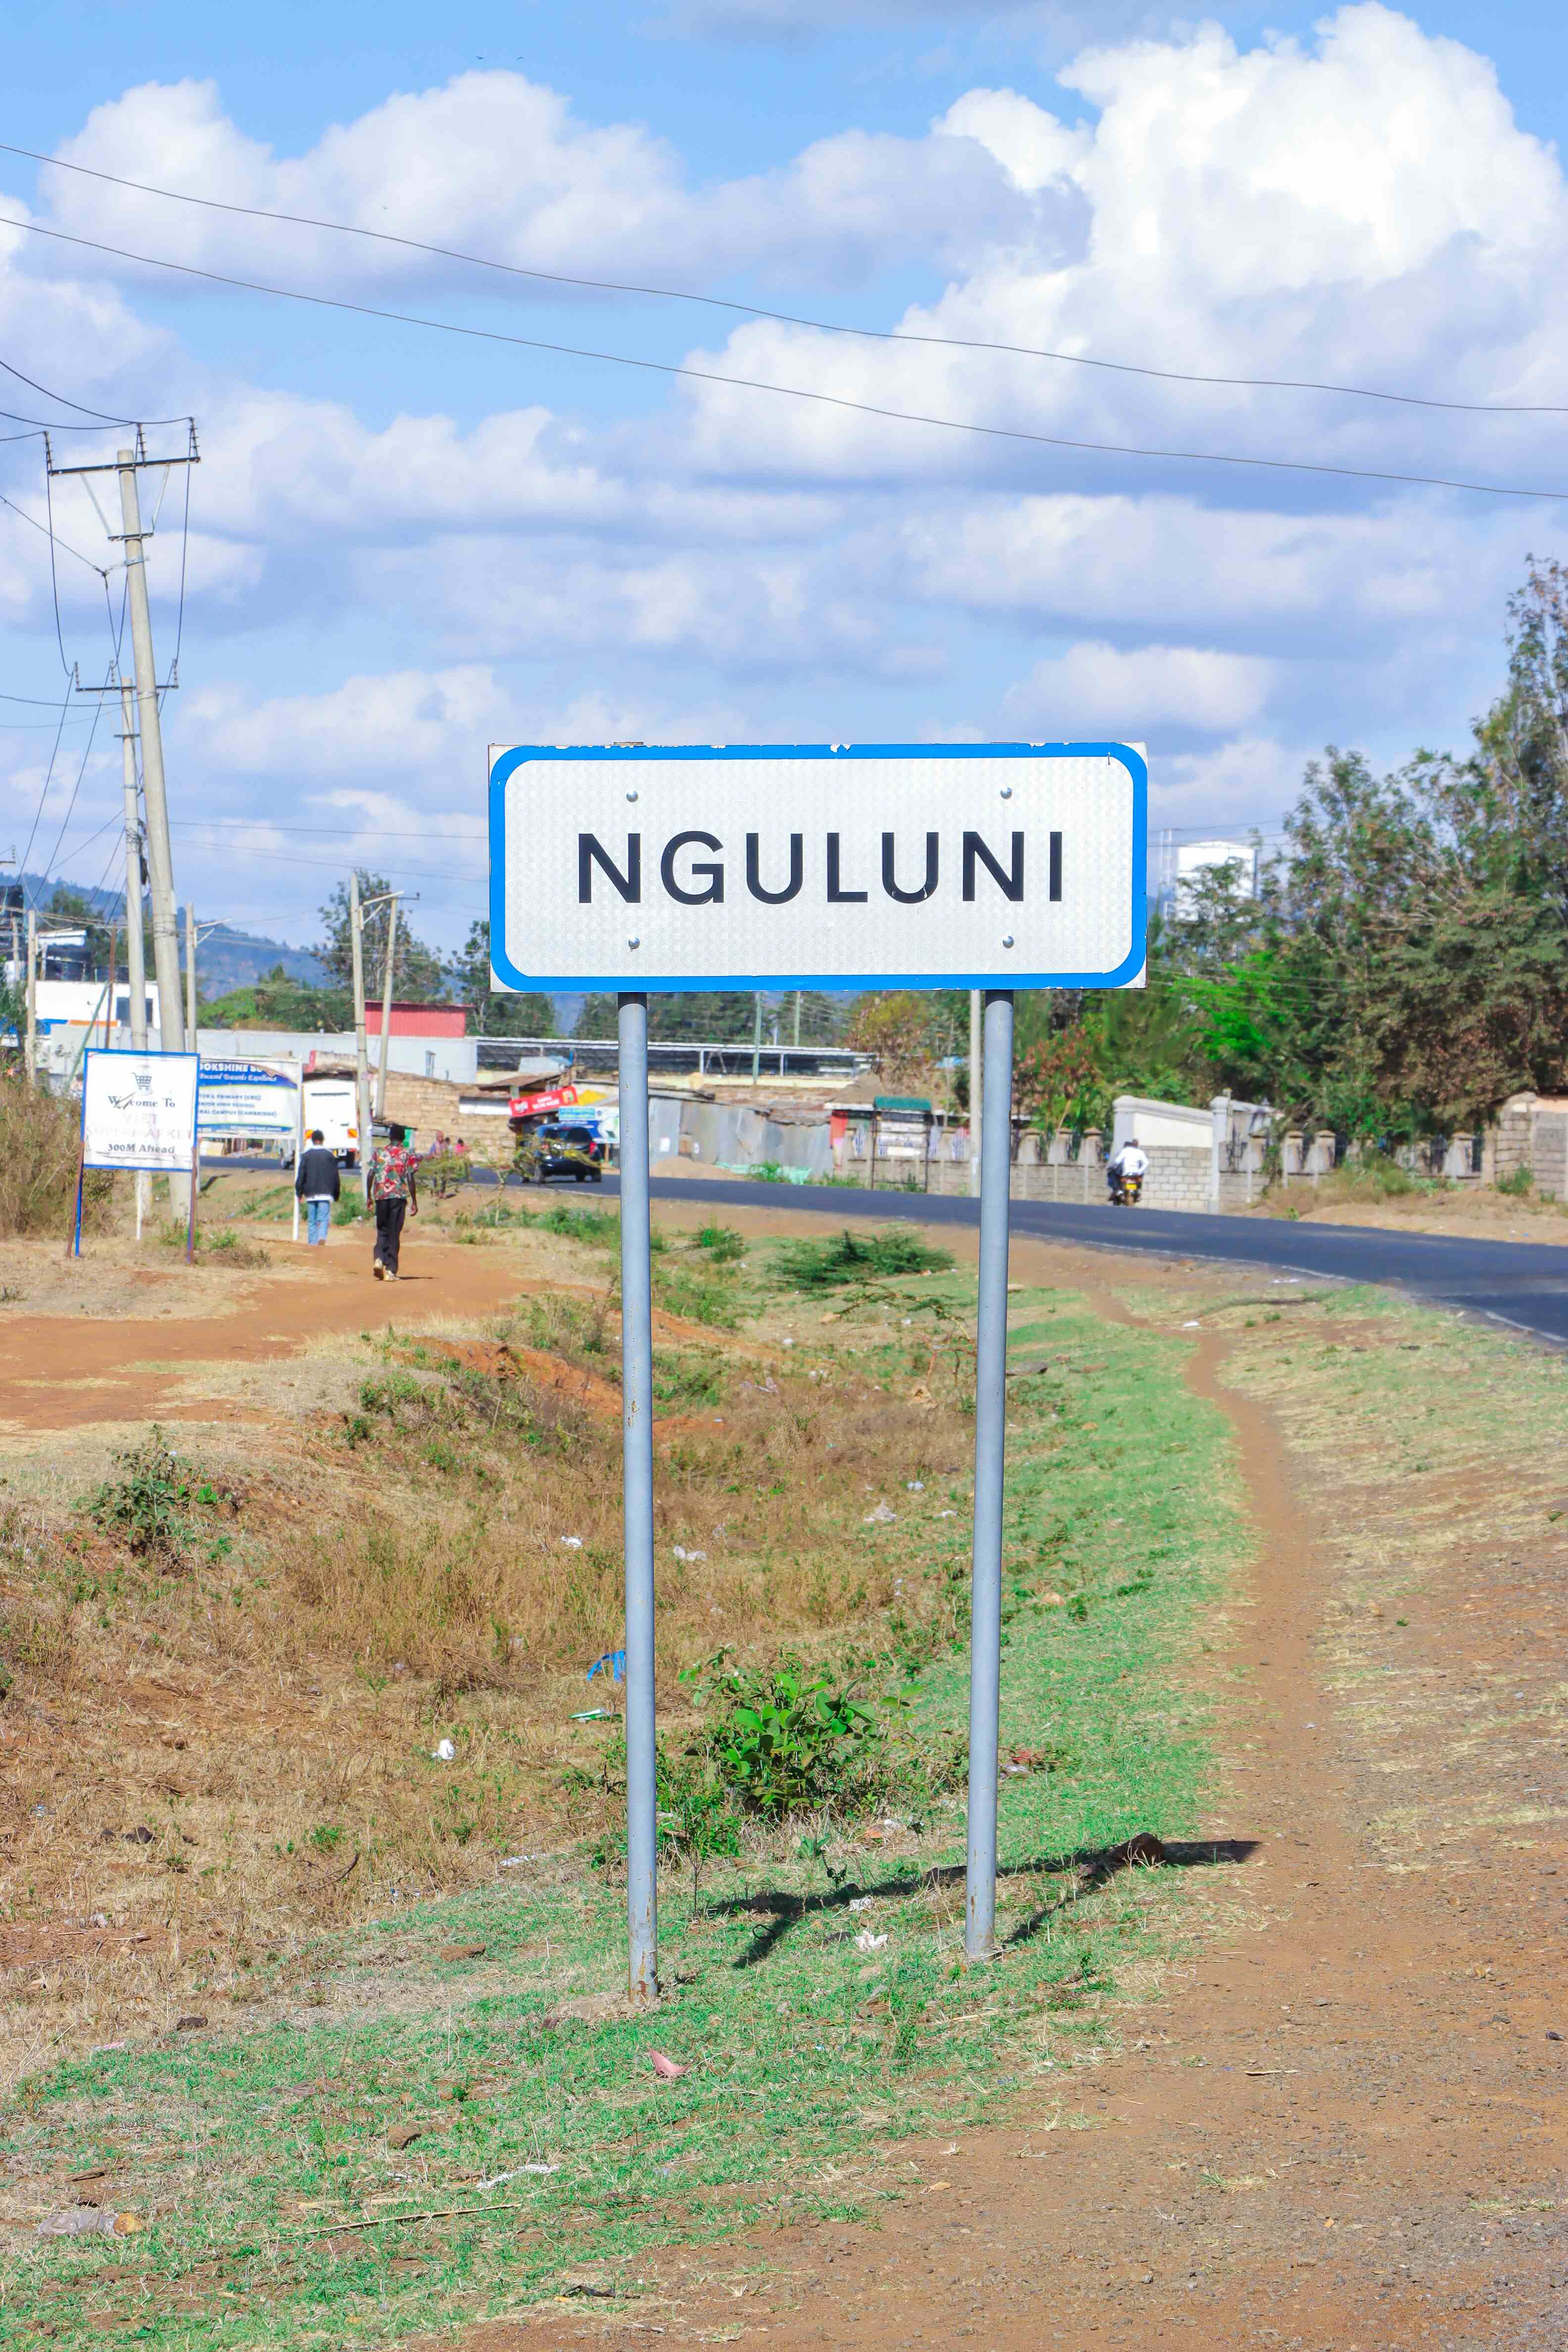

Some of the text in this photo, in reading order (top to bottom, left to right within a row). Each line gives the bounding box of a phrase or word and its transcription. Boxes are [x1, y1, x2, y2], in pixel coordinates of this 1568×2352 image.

[578, 830, 1063, 905] NGULUNI
[162, 1097, 176, 1108] To
[107, 1143, 175, 1154] 300M Ahead
